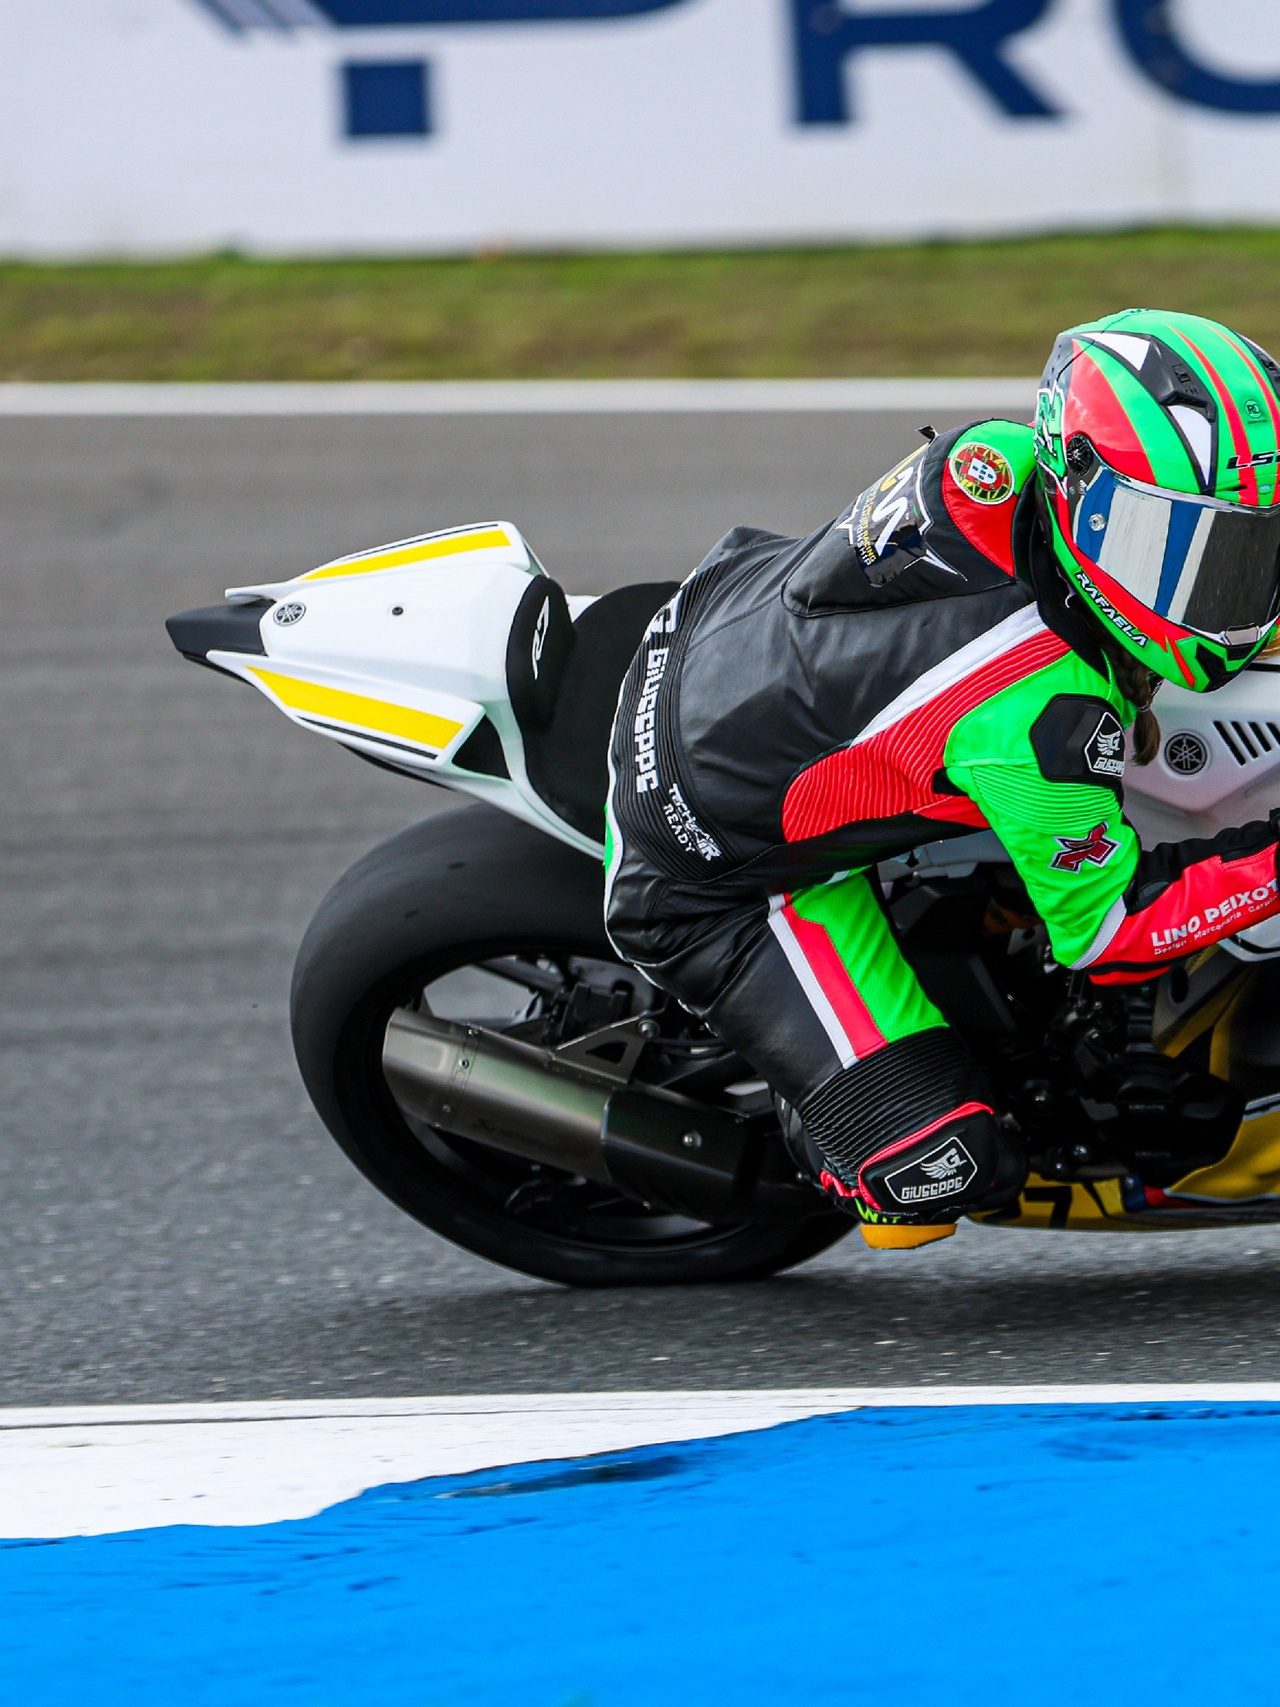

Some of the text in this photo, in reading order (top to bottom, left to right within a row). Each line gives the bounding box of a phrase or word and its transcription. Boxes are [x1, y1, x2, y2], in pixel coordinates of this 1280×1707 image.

[1075, 571, 1150, 648] RAFAELA
[663, 803, 696, 853] READY
[1151, 878, 1278, 947] LINO PEIXOT
